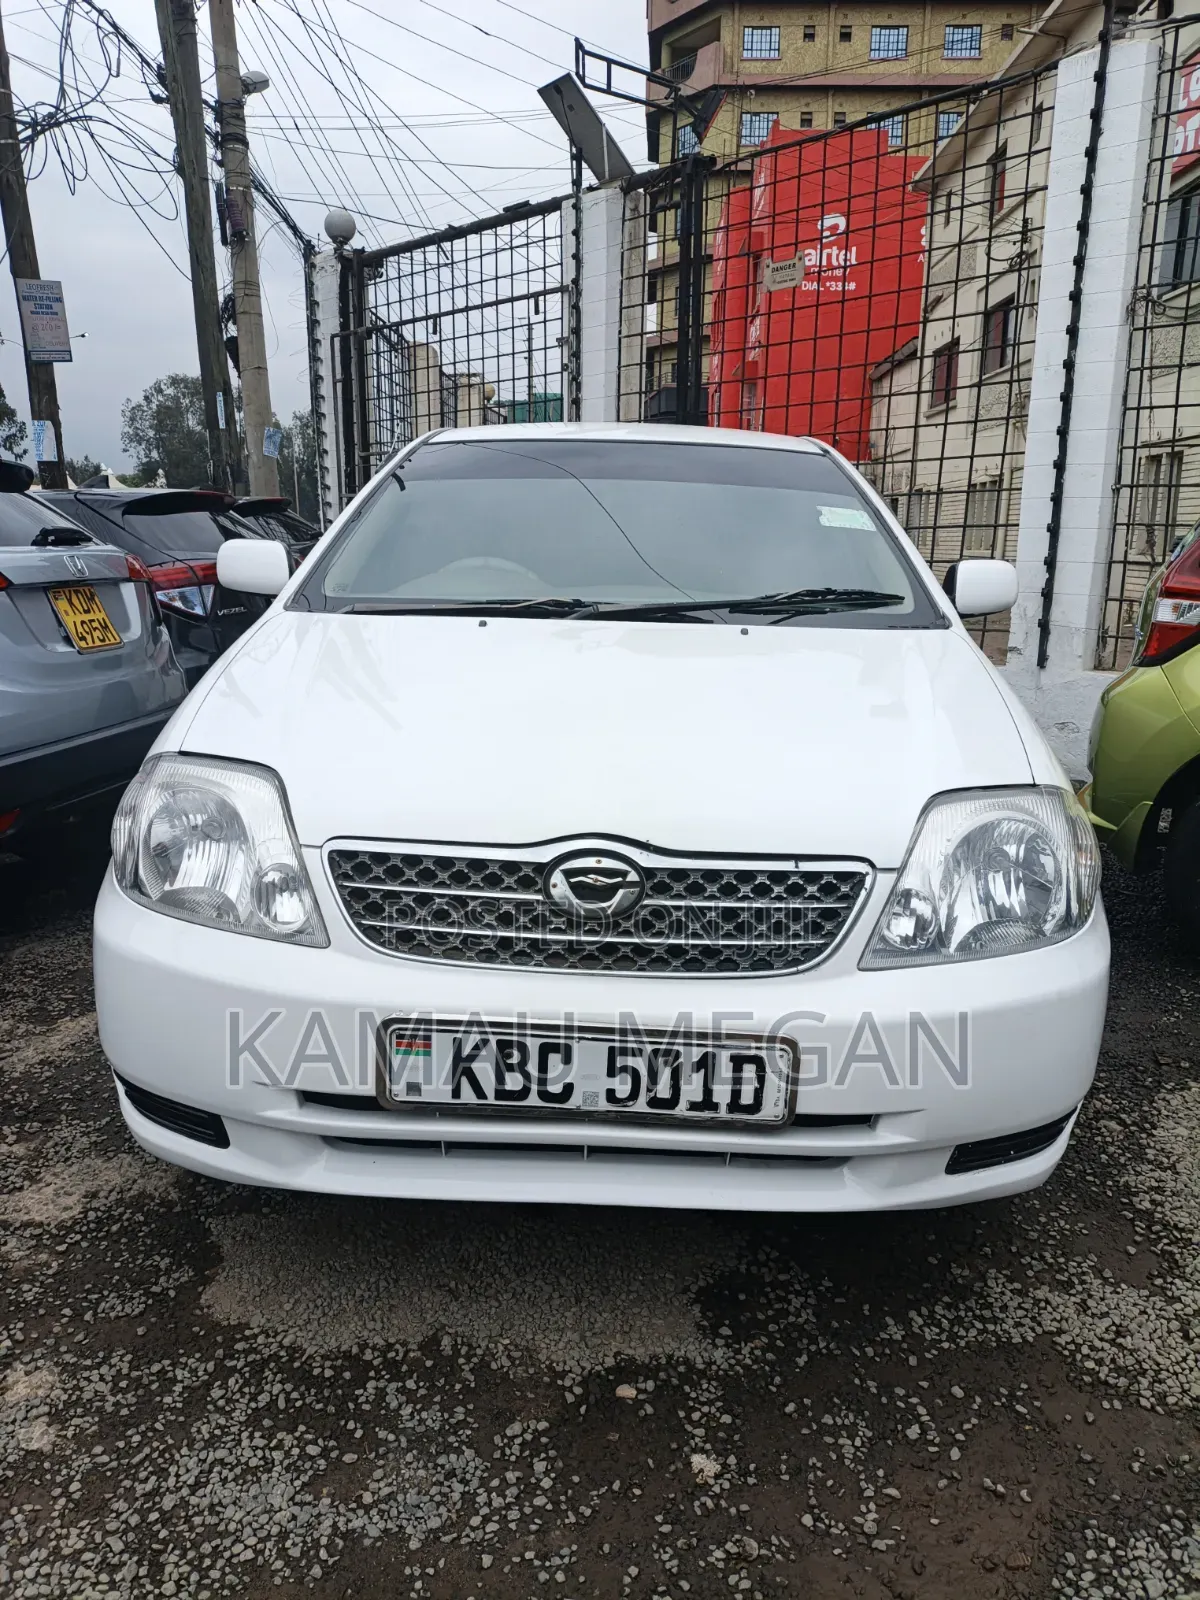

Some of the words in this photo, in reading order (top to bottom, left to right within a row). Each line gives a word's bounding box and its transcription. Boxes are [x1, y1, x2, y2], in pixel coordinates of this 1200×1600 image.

[804, 244, 858, 266] airtel
[771, 262, 797, 274] DANGER
[801, 281, 825, 291] DIAL
[61, 588, 102, 616] KDM
[216, 606, 248, 616] VEZEL
[72, 617, 117, 646] 495M
[451, 1036, 575, 1105] KBC
[605, 1045, 767, 1115] 501D
